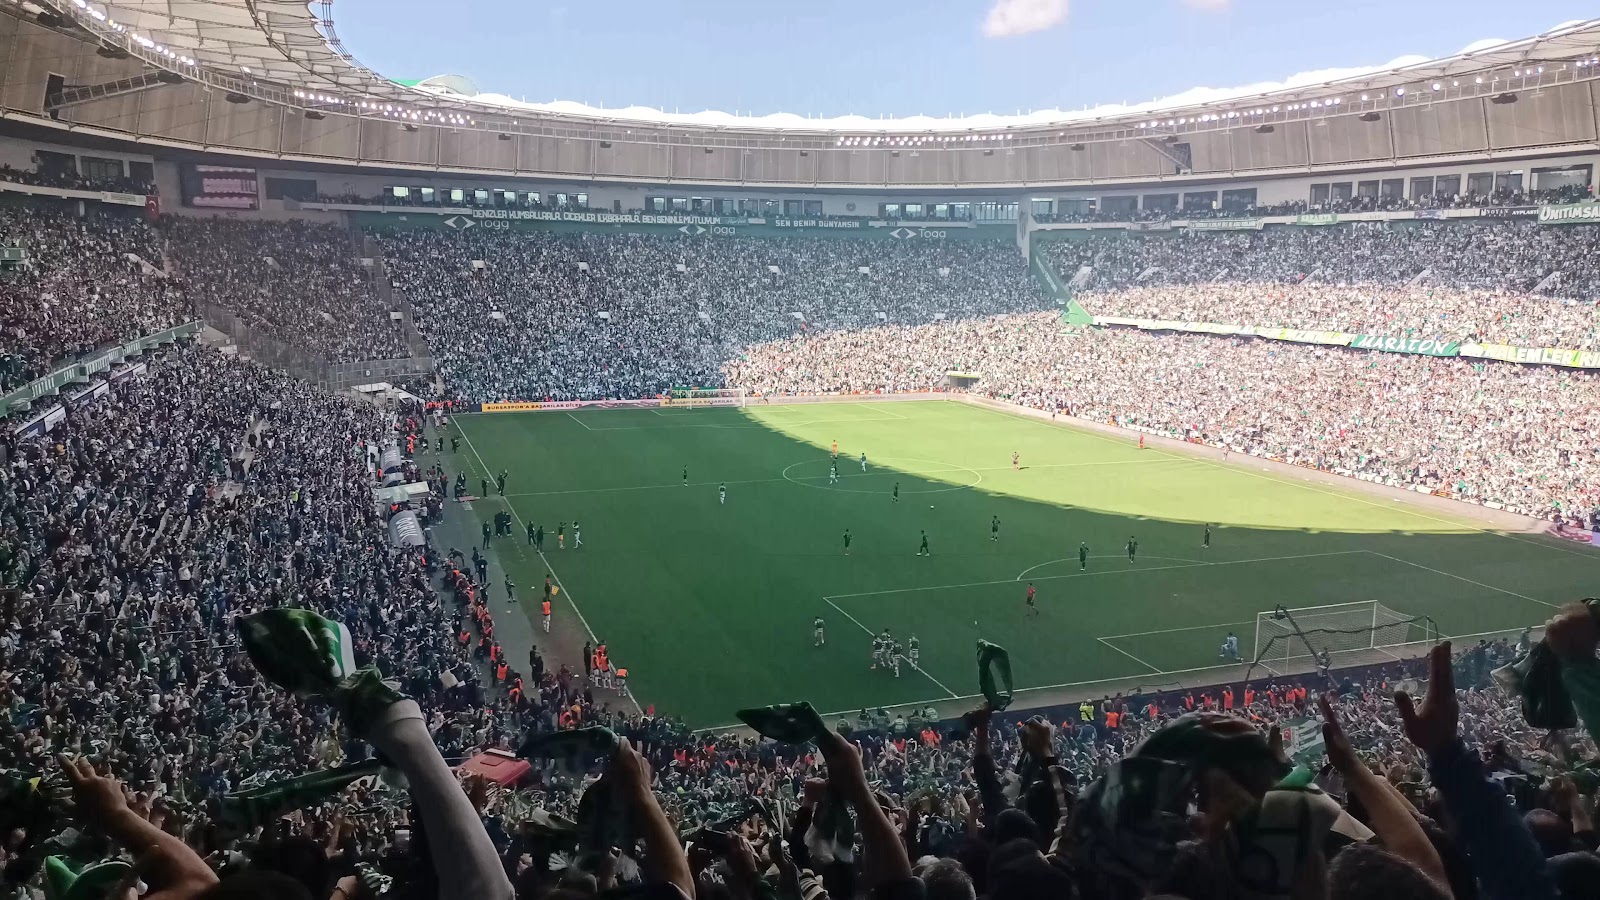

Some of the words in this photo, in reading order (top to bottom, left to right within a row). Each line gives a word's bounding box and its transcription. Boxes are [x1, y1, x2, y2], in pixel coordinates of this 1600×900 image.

[775, 219, 791, 227] SEN
[709, 224, 736, 235] Togg
[1358, 335, 1449, 354] MARATON
